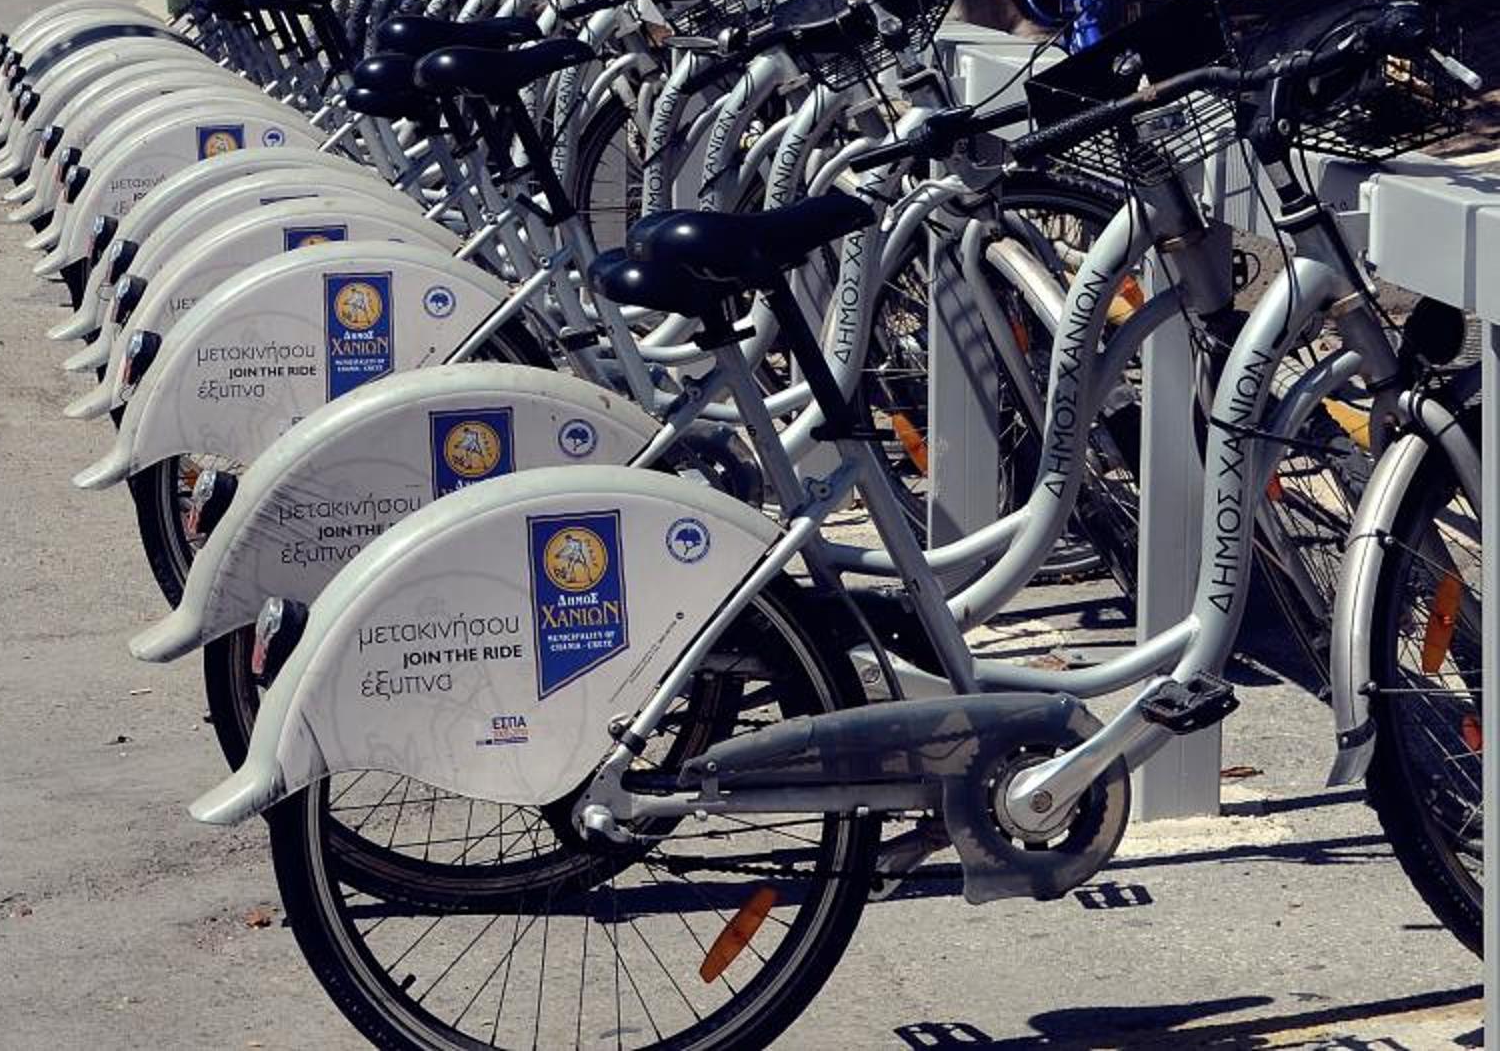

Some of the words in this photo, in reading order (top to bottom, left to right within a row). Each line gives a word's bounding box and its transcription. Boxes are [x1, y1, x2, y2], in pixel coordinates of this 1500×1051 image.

[768, 134, 806, 211] ΑΝΙΩΝ
[834, 275, 861, 364] ΔΗΜΟΣ
[1059, 269, 1109, 384] ΧΑΝΙΩΝ
[197, 341, 316, 367] μετακινήσου
[229, 368, 257, 380] JOIN
[261, 367, 284, 378] THE
[287, 365, 317, 377] RIDE
[197, 380, 265, 400] έξυπνα
[1219, 349, 1273, 481] ΧΑΝΙΩΝ
[1043, 389, 1078, 499] ΔΗΜΟΣ
[277, 493, 421, 526] μετακινήσου
[318, 525, 352, 541] JOIN
[1207, 489, 1241, 614] ΔΗΜΟΣ
[541, 601, 619, 629] ΧΑΝΙΩΝ
[358, 613, 521, 653] μετακινήσου
[403, 651, 442, 669] JOIN
[443, 648, 478, 664] THE
[483, 645, 523, 661] RIDE
[361, 670, 452, 701] έξυπνα
